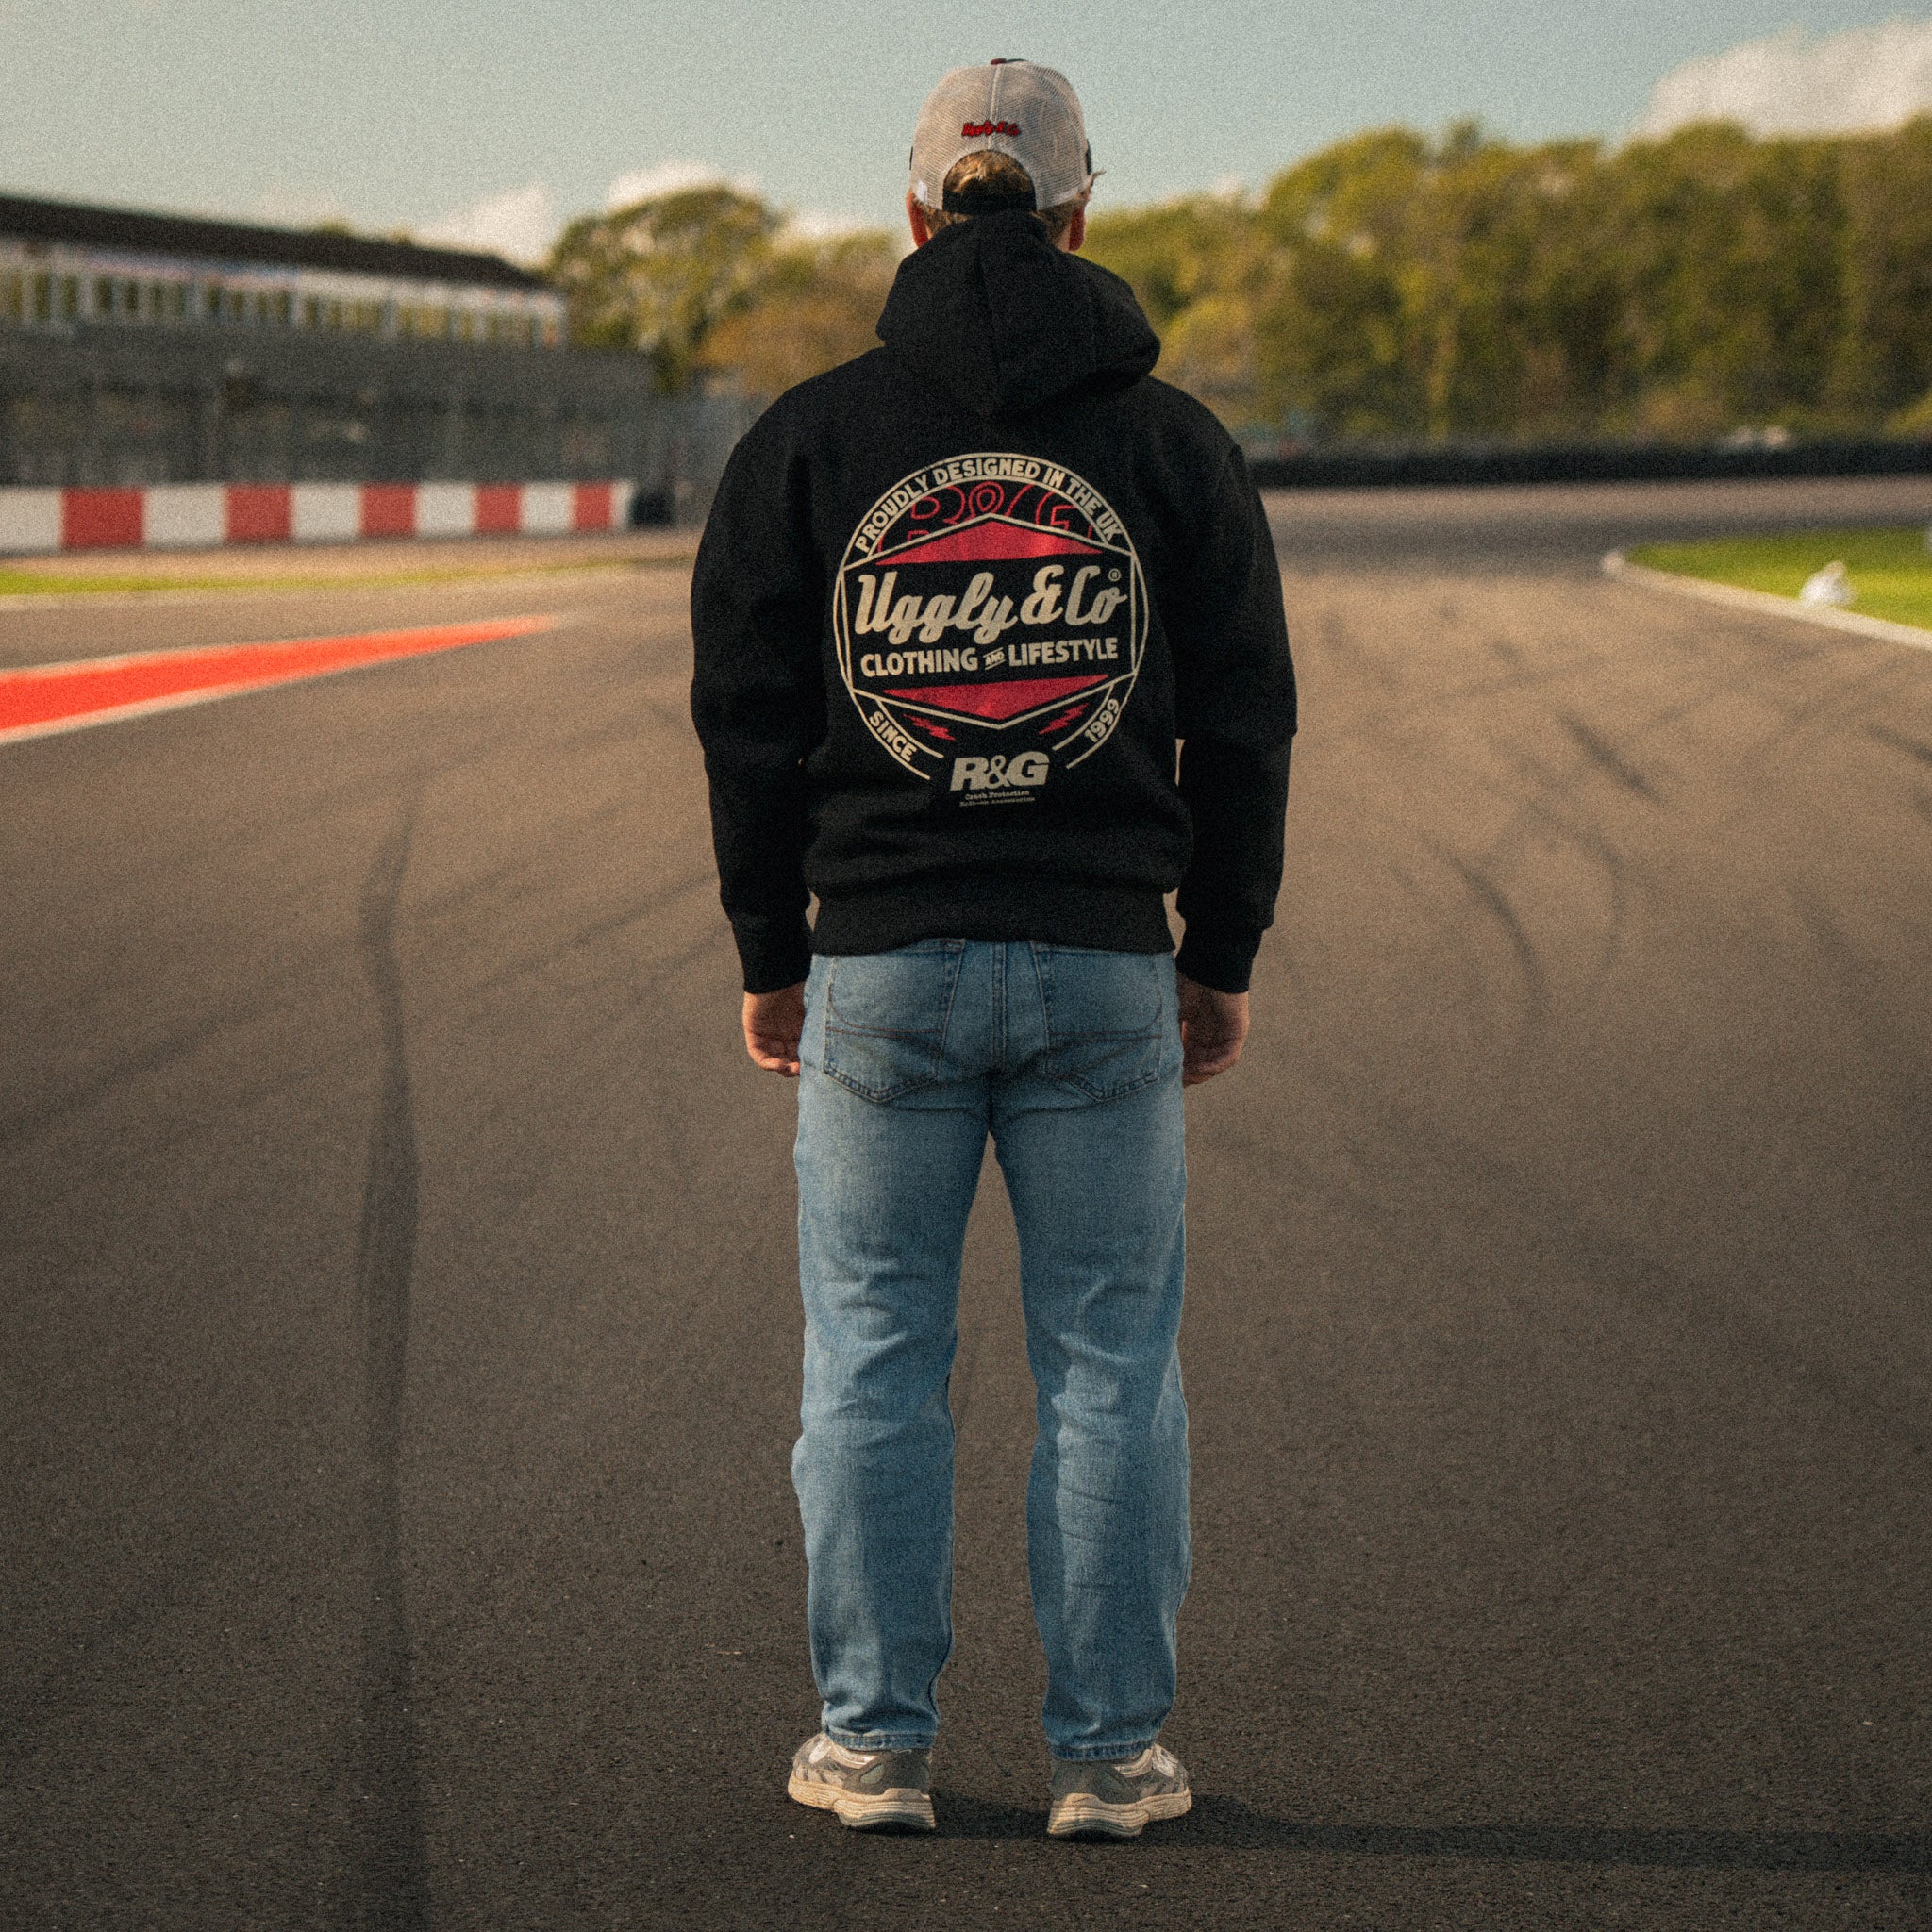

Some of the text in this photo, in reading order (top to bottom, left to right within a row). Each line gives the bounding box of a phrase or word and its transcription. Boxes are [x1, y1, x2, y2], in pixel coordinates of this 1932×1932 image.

[855, 474, 929, 553] PROUDLY
[932, 458, 1041, 485] DESIGNED
[1042, 467, 1066, 489] IN
[1065, 477, 1102, 516] THE
[1096, 511, 1124, 542] UK
[855, 571, 1018, 645] Uggly
[860, 637, 1119, 677] CLOTHING AND LIFESTYLE
[869, 710, 917, 761] SINCE
[1084, 698, 1121, 743] 1999
[950, 751, 1051, 791] R&G
